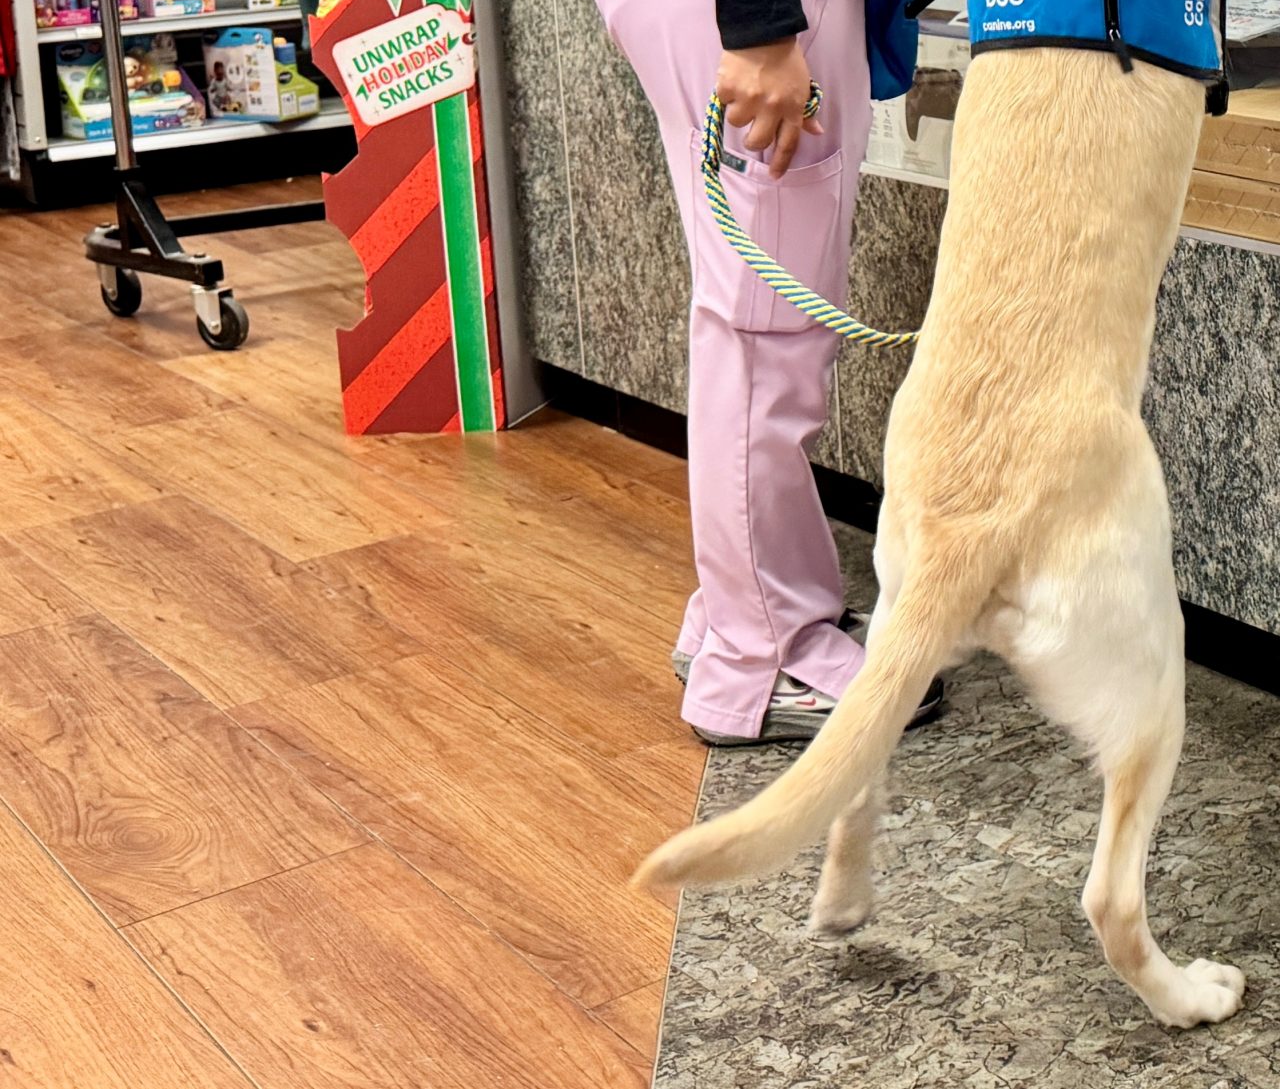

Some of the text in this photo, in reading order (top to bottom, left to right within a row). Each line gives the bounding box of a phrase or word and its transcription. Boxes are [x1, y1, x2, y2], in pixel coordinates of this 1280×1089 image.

[353, 18, 440, 73] UNWRAP
[983, 18, 1035, 33] canine.org
[362, 37, 449, 92] HOLIDAY
[379, 61, 453, 109] SNACKS
